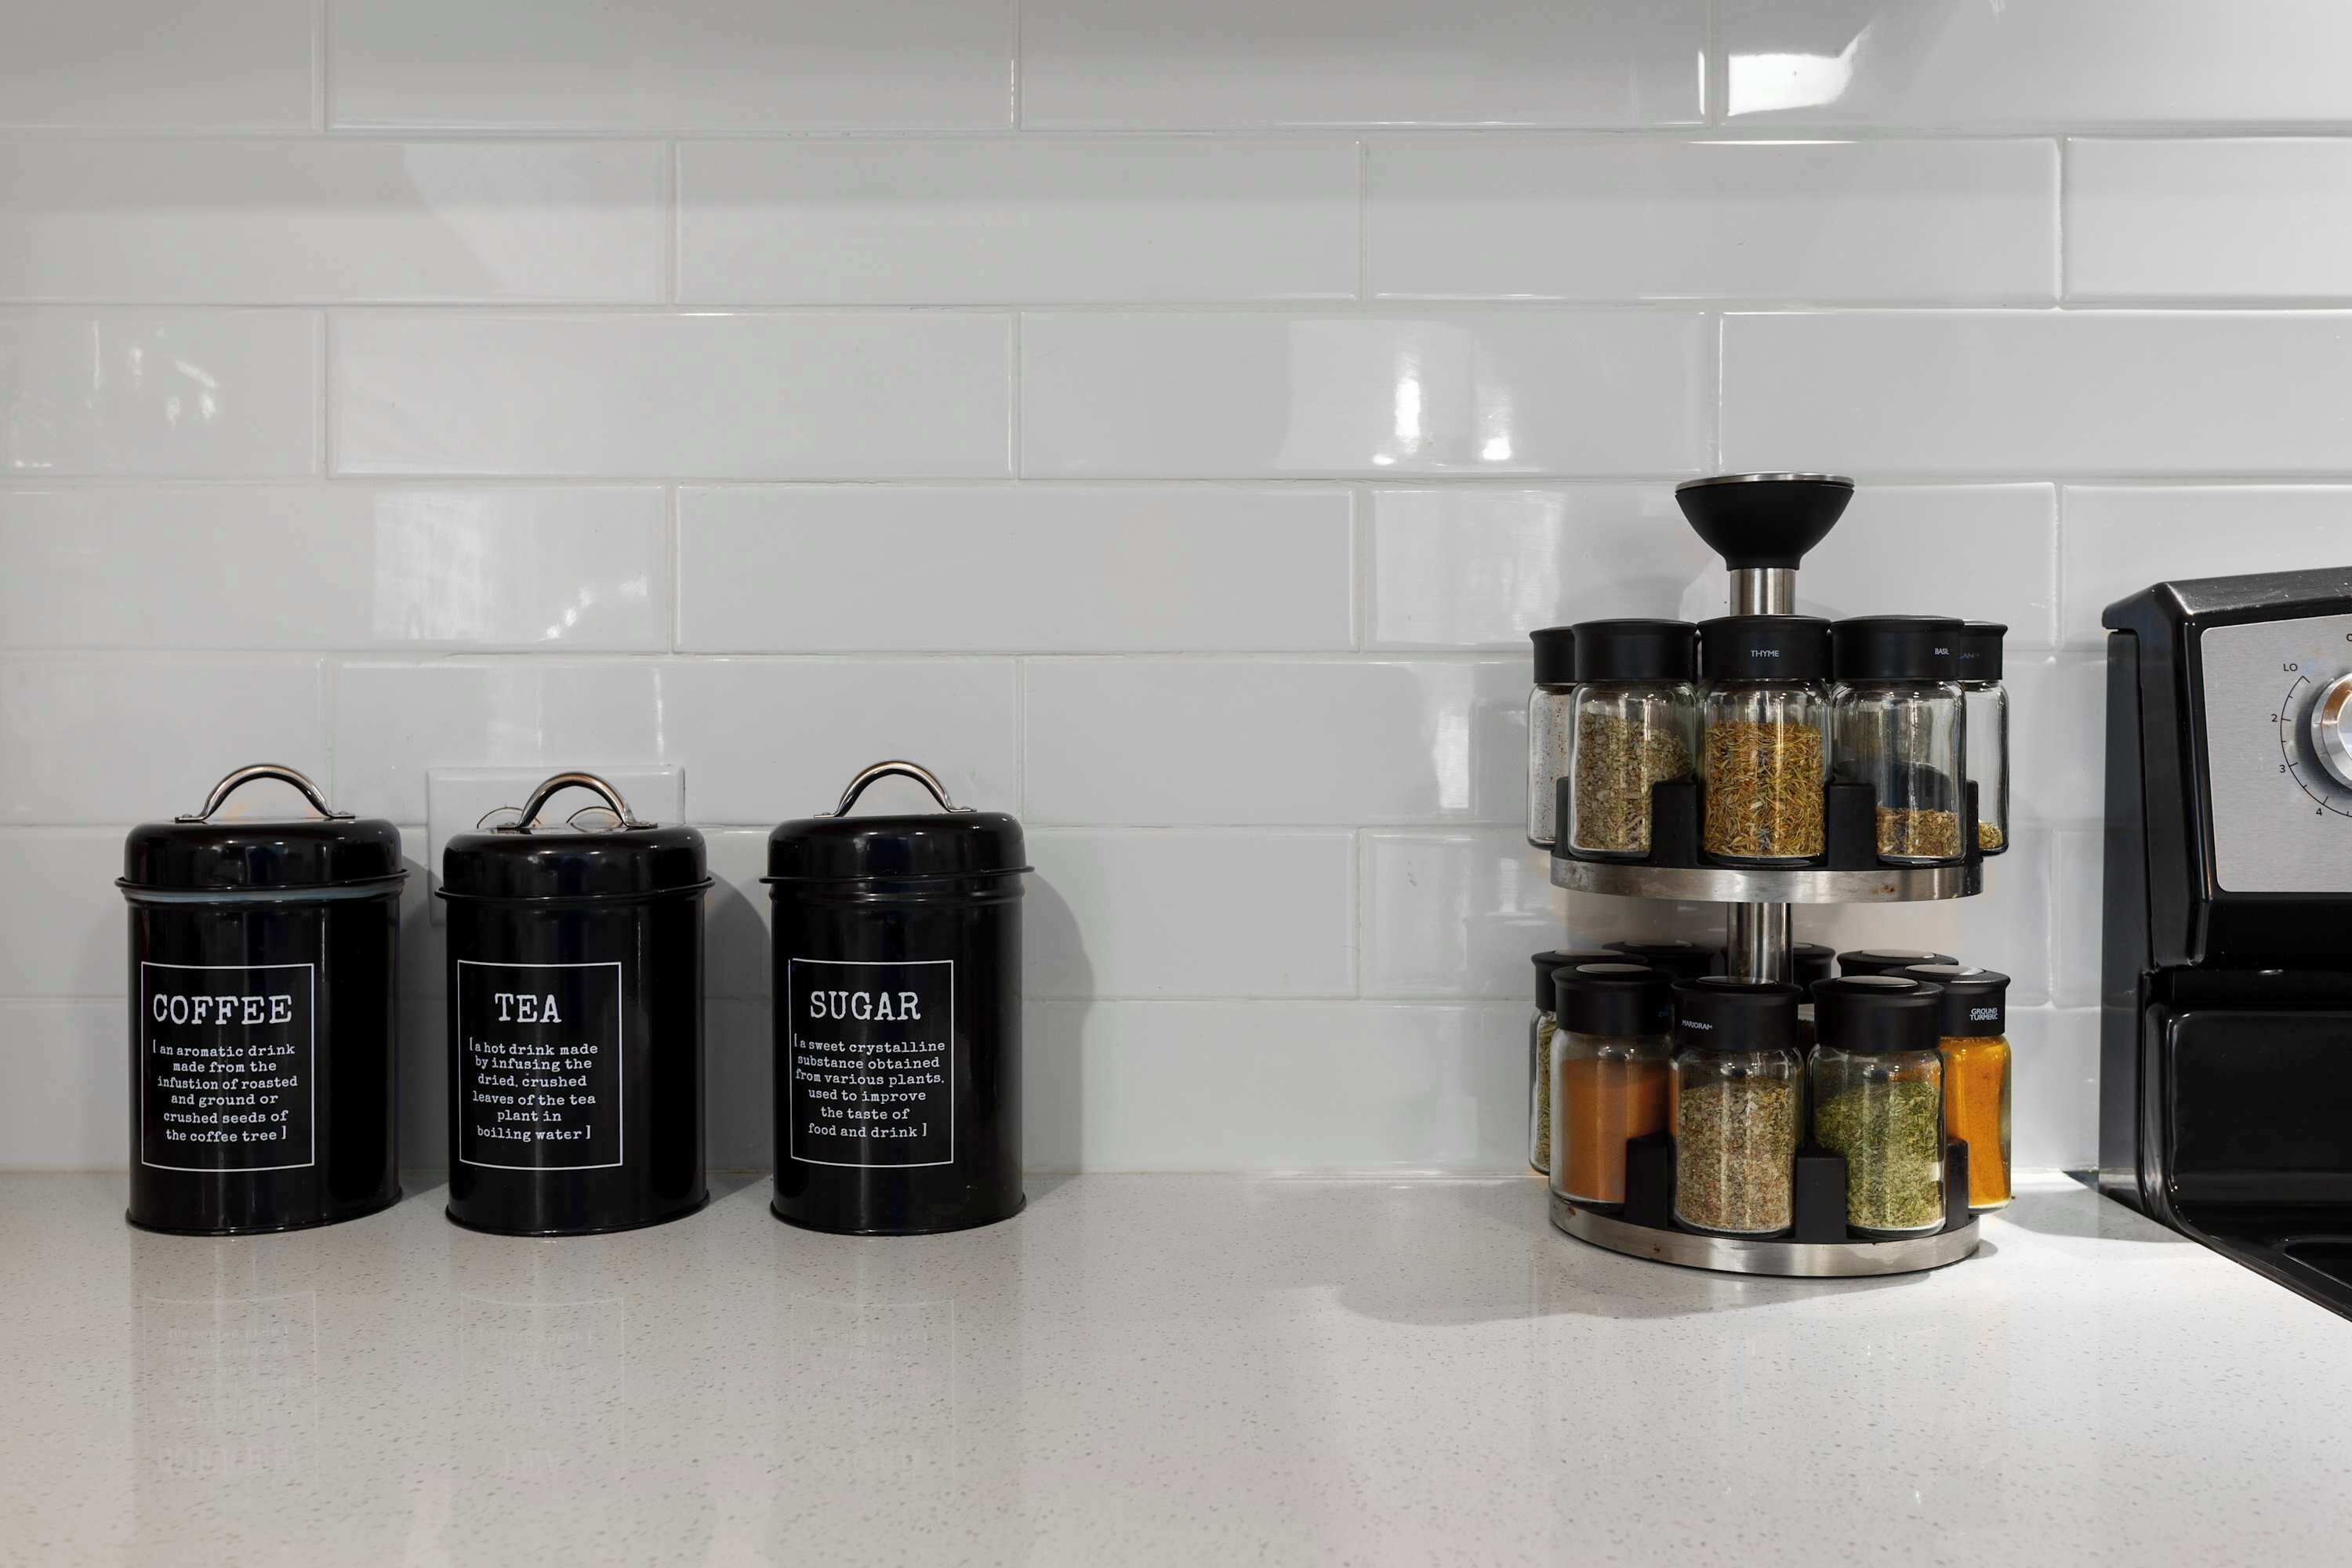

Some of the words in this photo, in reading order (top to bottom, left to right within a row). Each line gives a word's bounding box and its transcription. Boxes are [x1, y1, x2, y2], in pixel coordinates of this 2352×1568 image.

[2283, 663, 2298, 672] LO
[2271, 713, 2278, 722] 2
[2279, 764, 2286, 773] 3
[153, 993, 292, 1025] COFFEE
[494, 993, 562, 1023] TEA
[810, 990, 921, 1022] SUGAR
[1682, 1019, 1713, 1030] MARJORAM
[176, 1046, 244, 1058] aromatic
[248, 1043, 296, 1057] drink
[484, 1041, 506, 1054] hot
[508, 1043, 555, 1056] drink
[559, 1043, 598, 1055] made
[808, 1040, 846, 1052] sweet
[848, 1040, 946, 1056] crystalline
[172, 1061, 205, 1073] made
[209, 1061, 245, 1073] from
[249, 1060, 277, 1073] the
[474, 1054, 489, 1070] by
[492, 1057, 561, 1073] infusing
[564, 1058, 593, 1070] the
[797, 1054, 864, 1069] substance
[867, 1056, 941, 1070] obtained
[158, 1076, 219, 1091] infustion
[222, 1078, 239, 1091] of
[241, 1075, 299, 1090] roasted
[521, 1076, 588, 1088] crushed
[795, 1068, 822, 1083] from
[823, 1073, 884, 1085] various
[171, 1093, 195, 1105] and
[198, 1093, 256, 1109] ground
[260, 1094, 279, 1105] or
[472, 1090, 514, 1105] leaves
[517, 1094, 536, 1106] of
[537, 1094, 565, 1106] the
[568, 1094, 597, 1105] tea
[808, 1088, 838, 1100] used
[840, 1089, 858, 1102] to
[861, 1091, 927, 1105] improve
[163, 1112, 219, 1124] crushed
[222, 1111, 267, 1124] seeds
[270, 1109, 289, 1122] of
[497, 1109, 539, 1123] plant
[543, 1110, 562, 1122] in
[820, 1106, 844, 1119] the
[846, 1107, 888, 1120] taste
[891, 1108, 910, 1120] of
[165, 1128, 187, 1142] the
[190, 1131, 238, 1142] coffee
[241, 1131, 278, 1142] tree
[477, 1124, 532, 1143] boiling
[535, 1129, 583, 1141] water
[808, 1122, 837, 1136] food
[840, 1126, 867, 1138] and
[870, 1126, 918, 1138] drink
